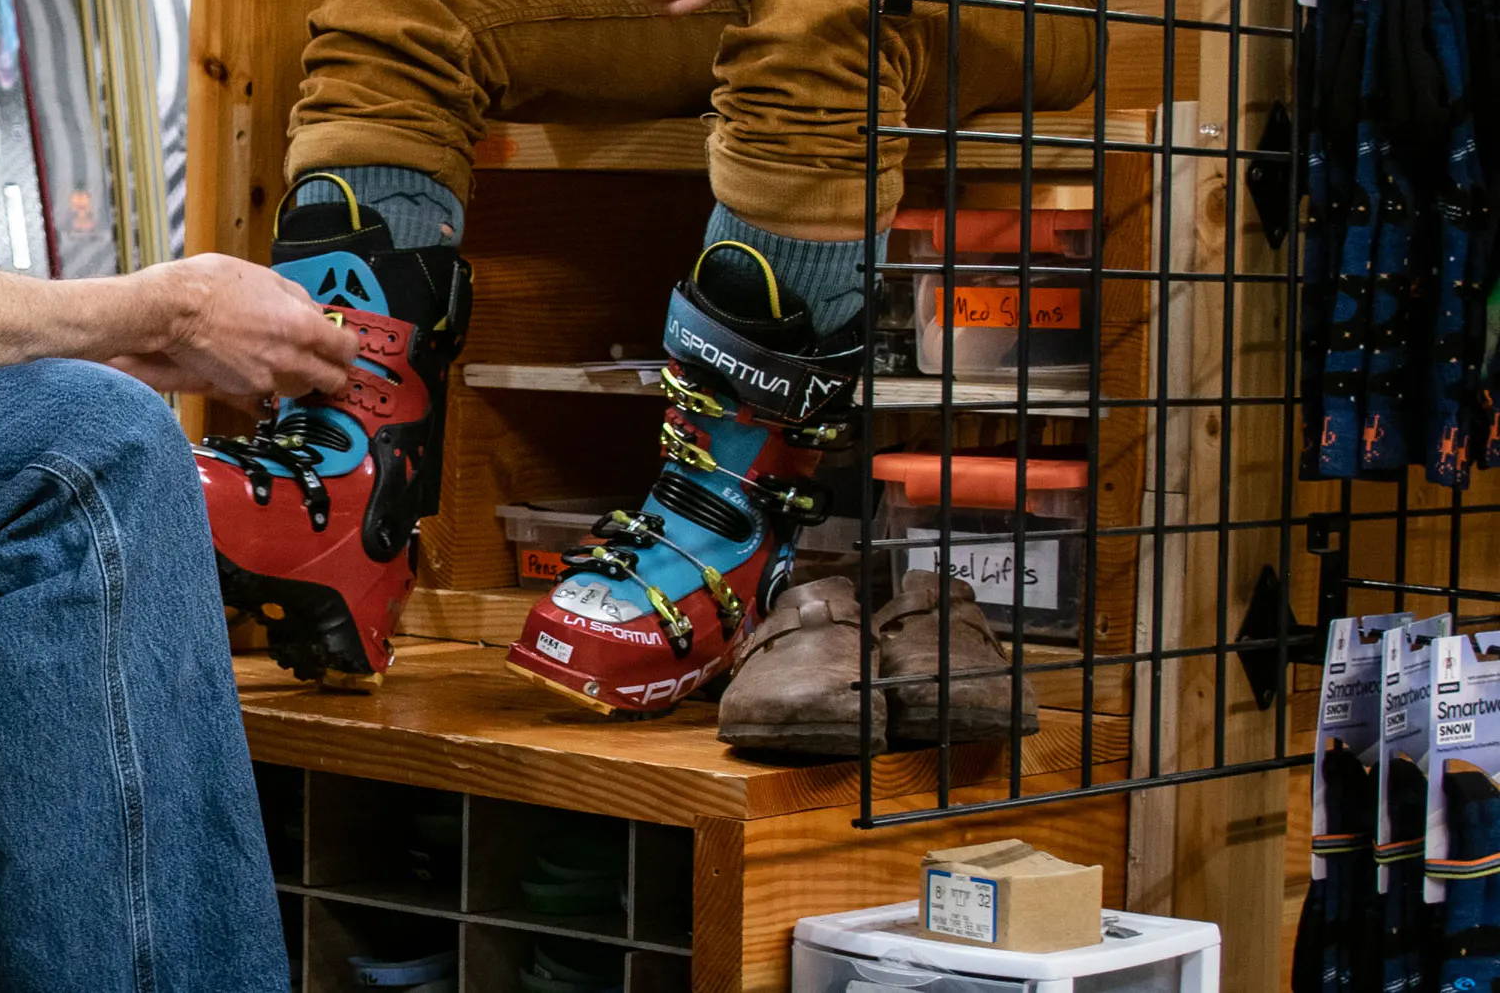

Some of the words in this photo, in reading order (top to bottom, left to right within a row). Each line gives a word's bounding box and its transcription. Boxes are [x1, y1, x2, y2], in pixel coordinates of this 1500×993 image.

[679, 328, 790, 397] SPORTIVA
[563, 614, 586, 628] LA
[589, 620, 663, 646] SPORTIVA
[1326, 703, 1349, 716] SNOW
[1386, 713, 1406, 727] SNOW
[1439, 722, 1472, 736] SNOW
